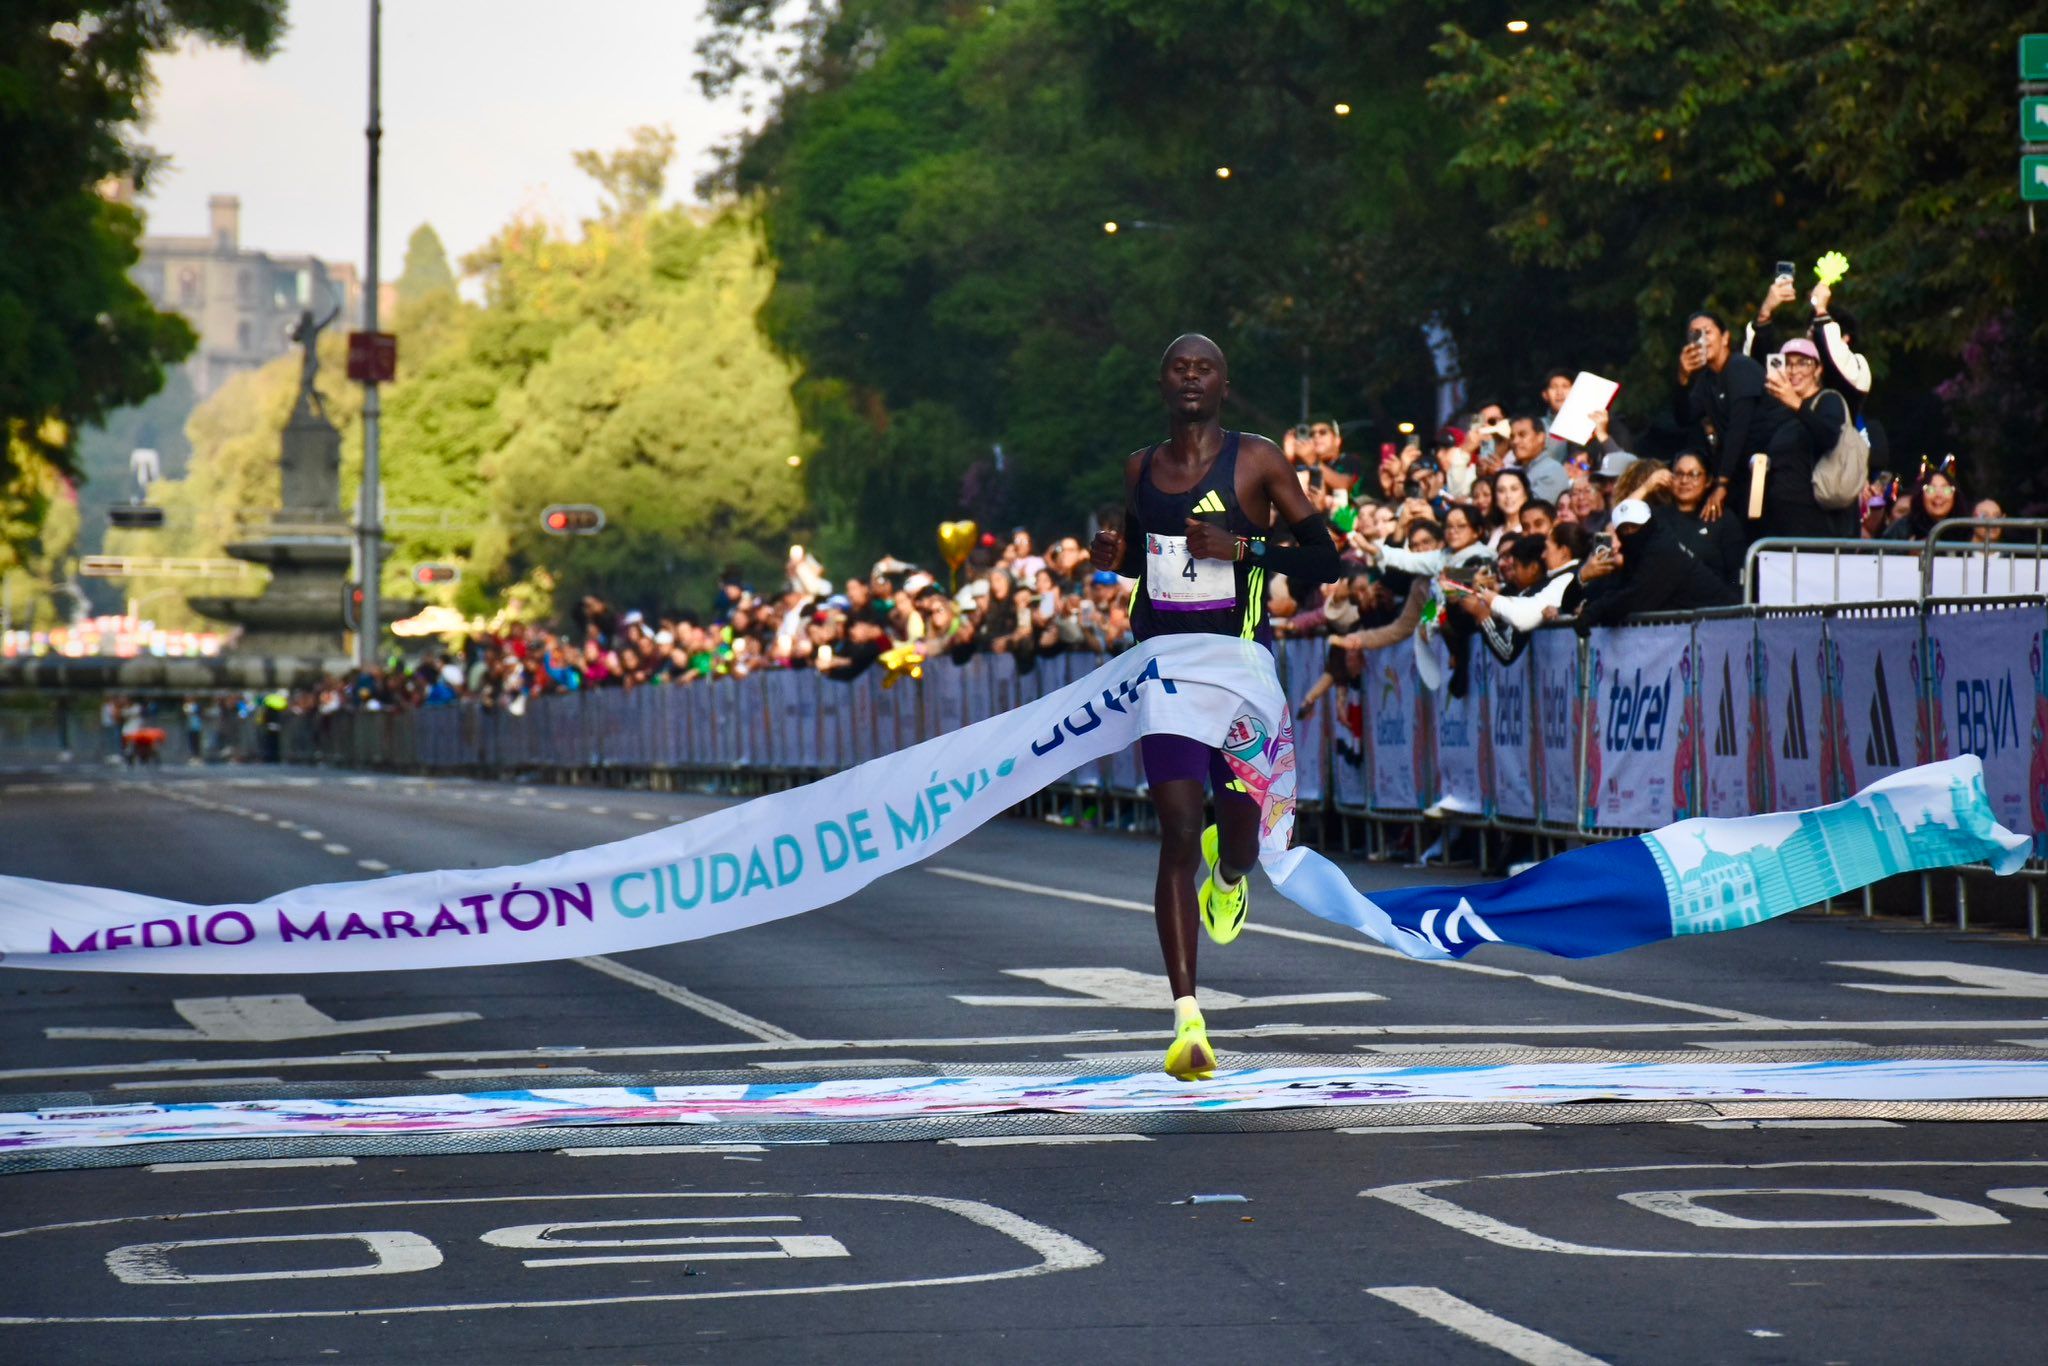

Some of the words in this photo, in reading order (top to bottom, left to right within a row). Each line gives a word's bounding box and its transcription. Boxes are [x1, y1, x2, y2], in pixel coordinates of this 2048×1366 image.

[1182, 558, 1198, 583] 4
[1606, 667, 1672, 751] telcel
[1955, 668, 2020, 761] BBVA
[278, 881, 594, 942] MARATÓN
[611, 834, 804, 919] CIUDAD
[816, 808, 880, 873] DE
